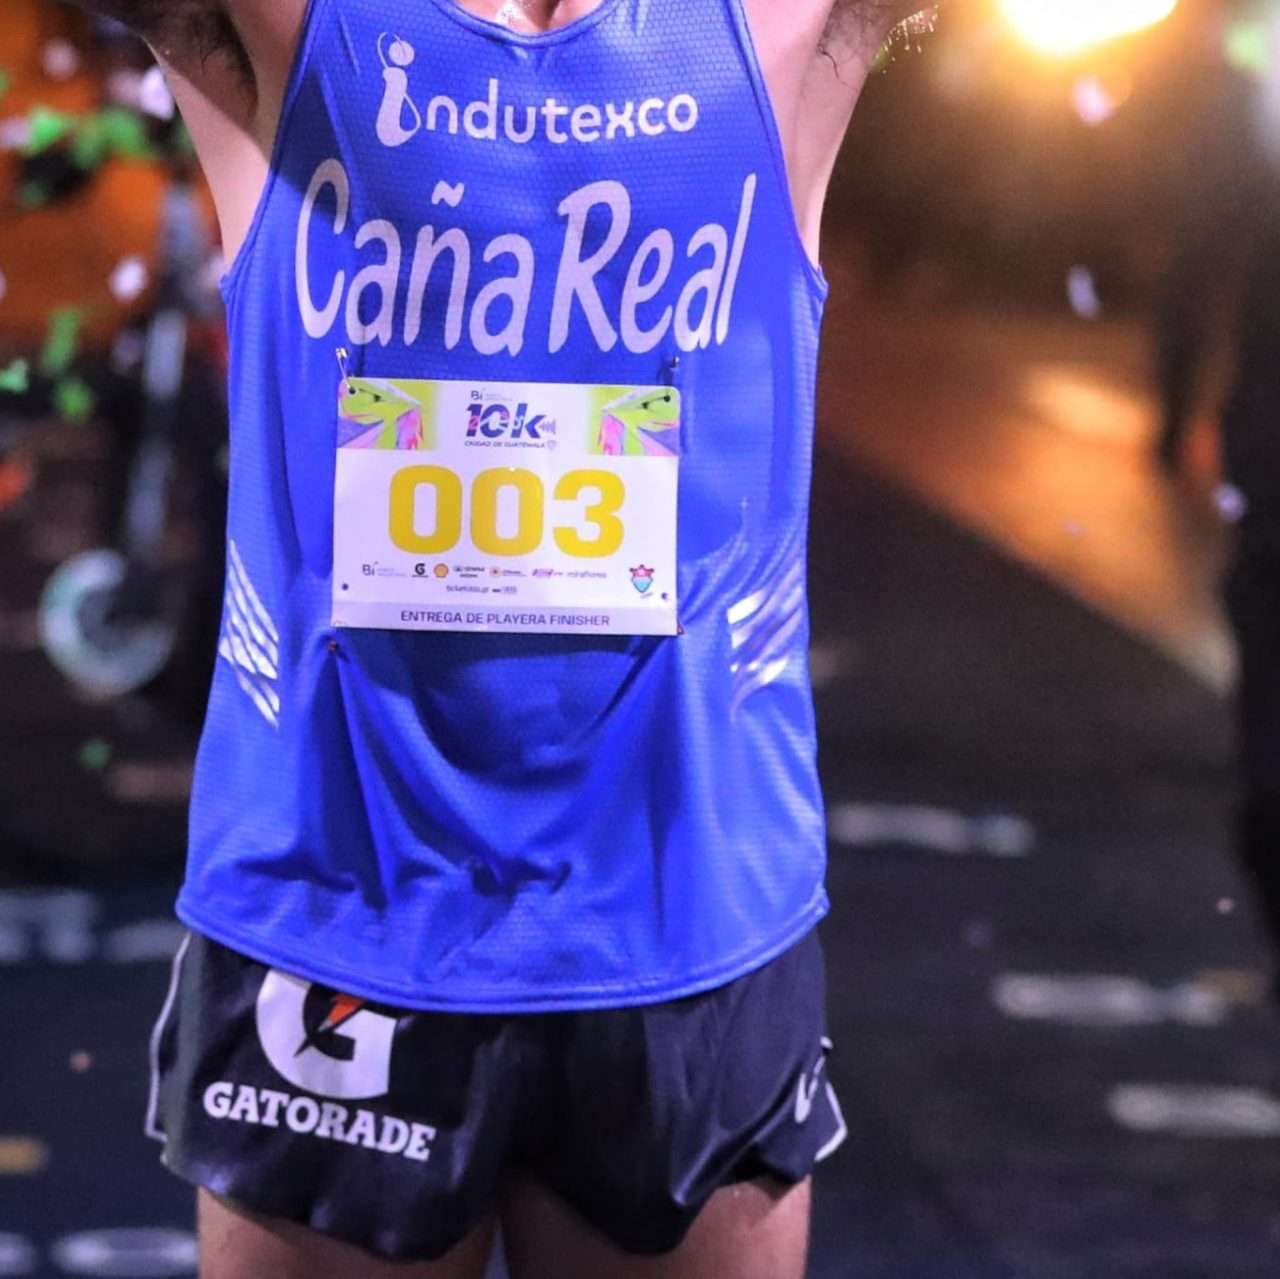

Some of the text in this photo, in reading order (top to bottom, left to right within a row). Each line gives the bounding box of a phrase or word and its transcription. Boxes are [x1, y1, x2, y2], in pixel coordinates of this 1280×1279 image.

[376, 32, 699, 147] indutexco
[296, 158, 756, 357] Caña Real
[388, 465, 626, 558] 003
[401, 610, 610, 626] ENTREGA DE PLAYERA FINISHER
[256, 968, 396, 1100] G
[204, 1081, 436, 1162] GATORADE
